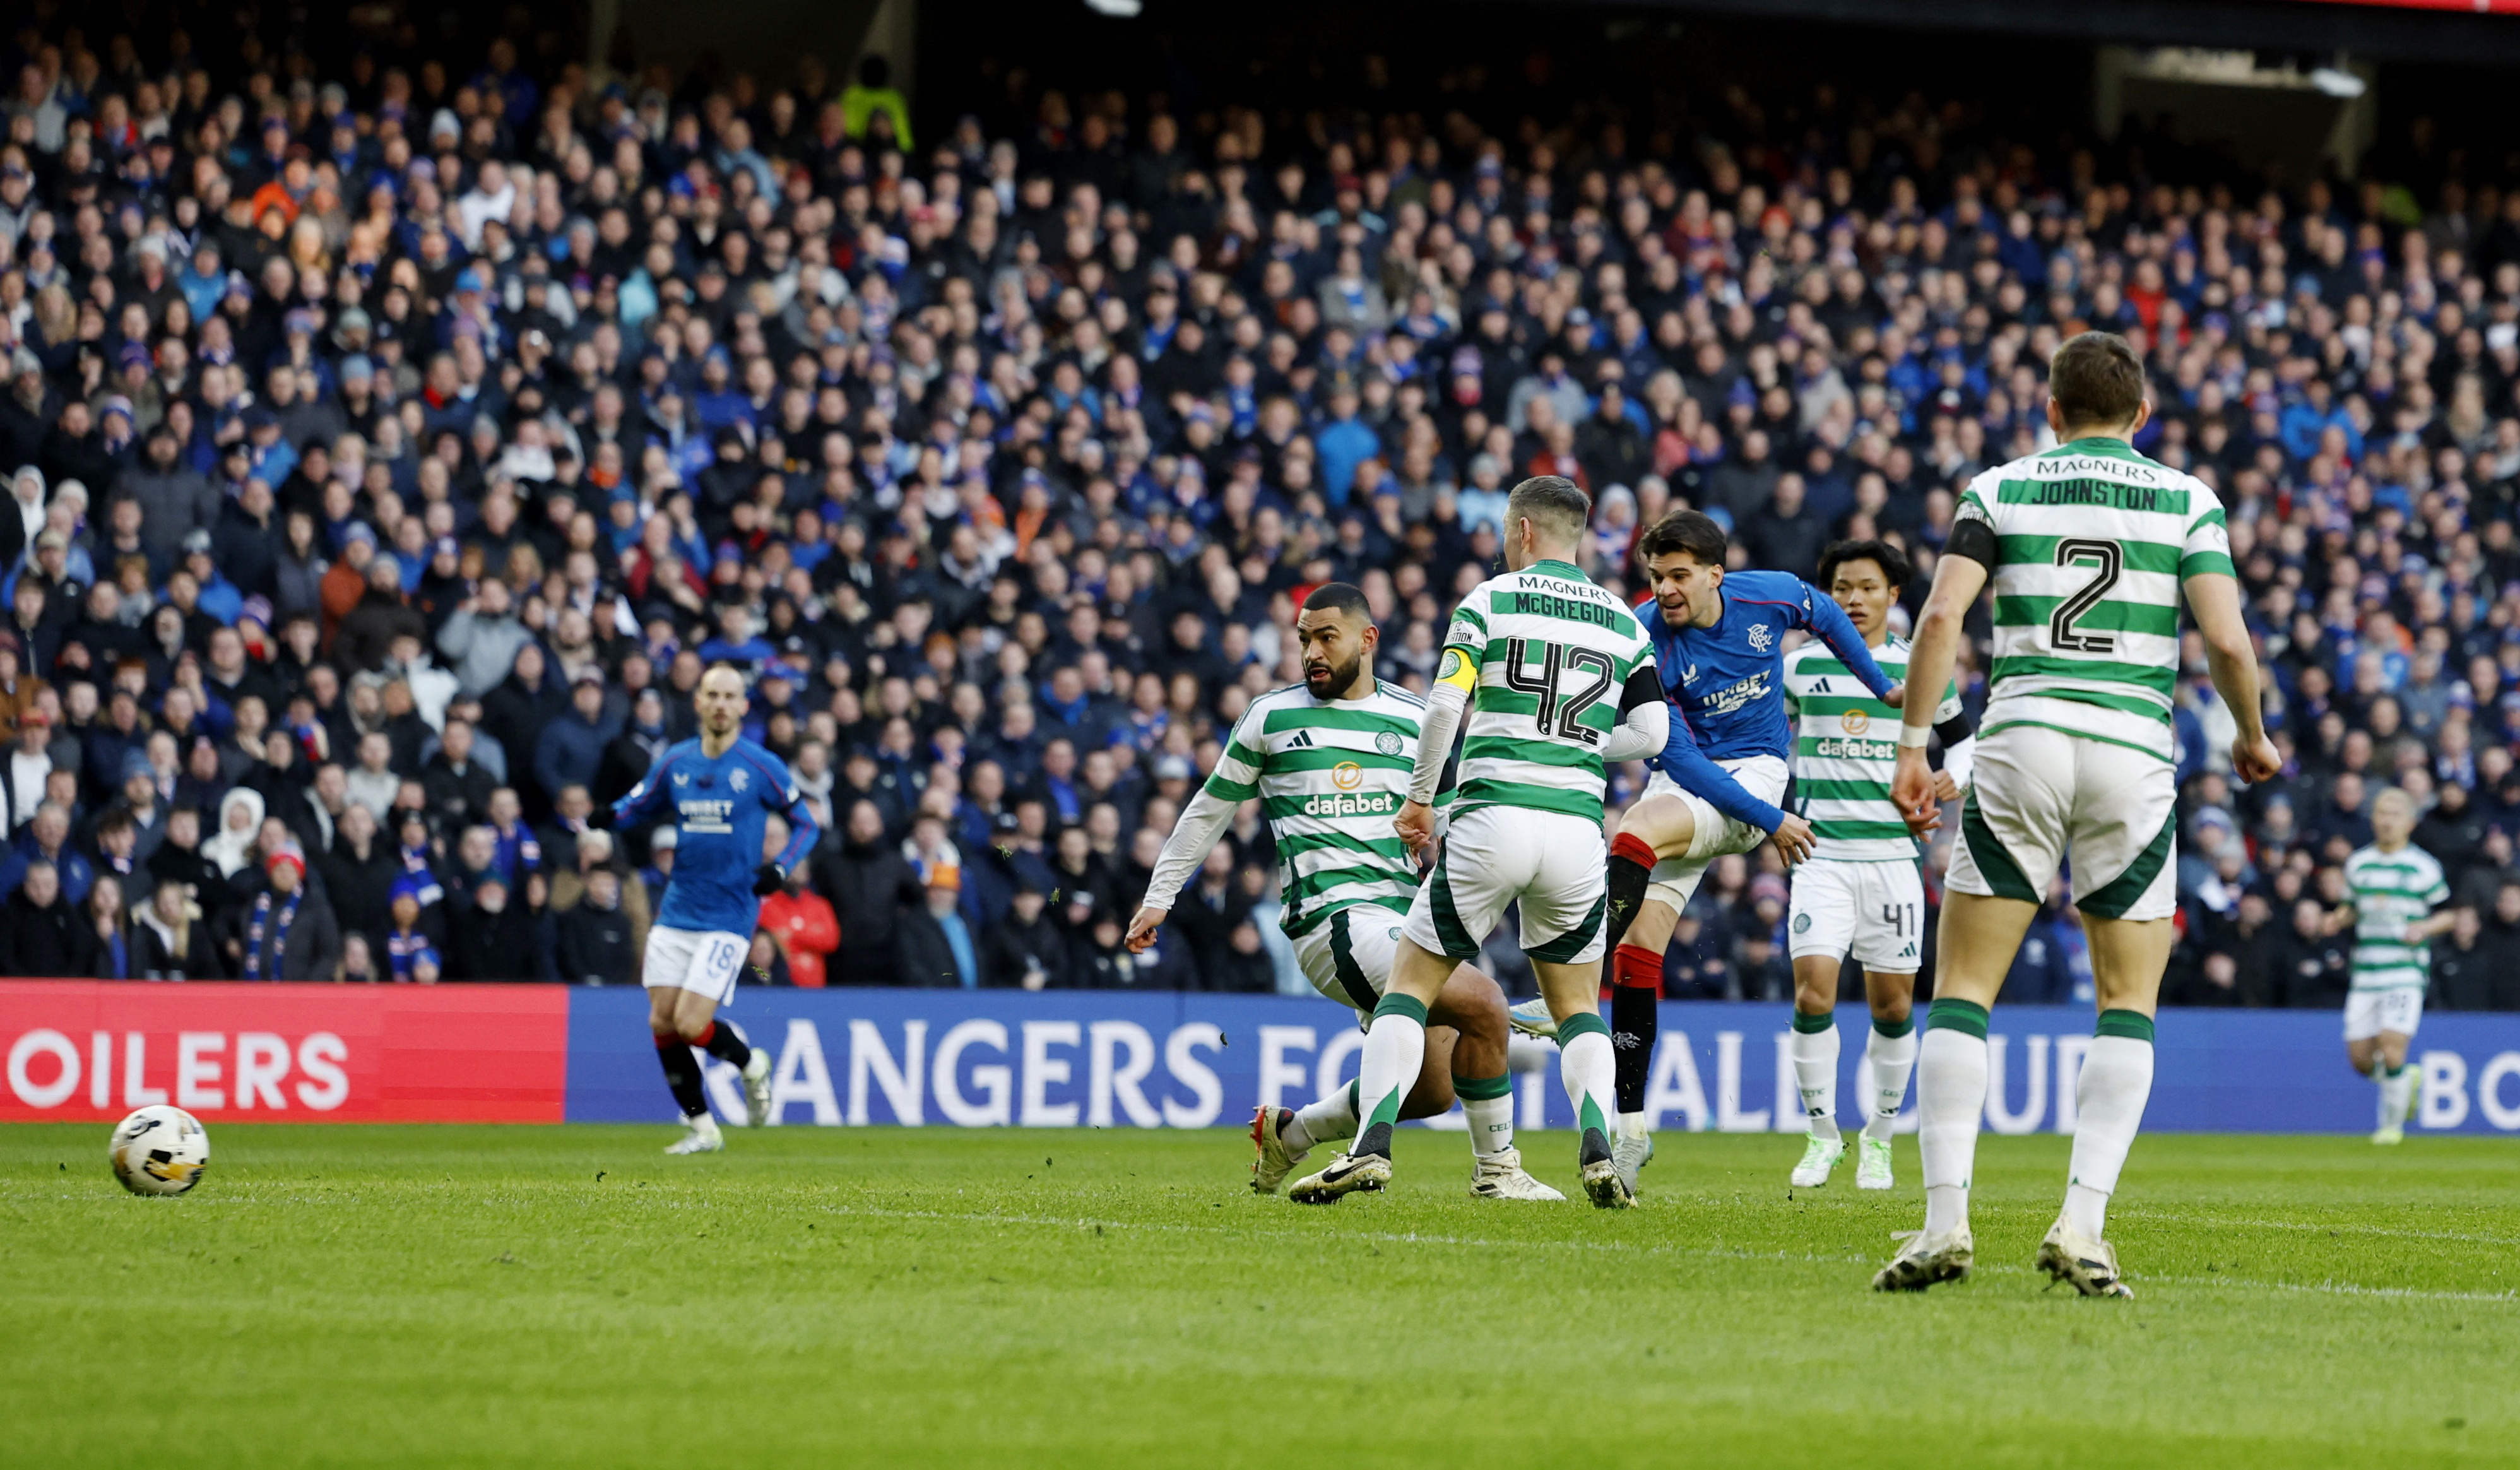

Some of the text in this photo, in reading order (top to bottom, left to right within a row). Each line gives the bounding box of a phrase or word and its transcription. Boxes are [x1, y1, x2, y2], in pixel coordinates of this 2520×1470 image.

[2037, 459, 2156, 483] MAGNERS
[2032, 480, 2157, 511] JOHNSTON
[1518, 576, 1612, 605] MAGNERS
[2050, 537, 2124, 656] 2
[1515, 592, 1616, 631] McGREGOR
[1505, 636, 1615, 748] 42
[1817, 737, 1895, 759] dafabet
[1304, 793, 1393, 817] dafabet
[1883, 903, 1914, 937] 41
[707, 939, 735, 970] 18
[6, 1028, 350, 1111] OILERS
[1258, 1026, 1816, 1134] FTALL
